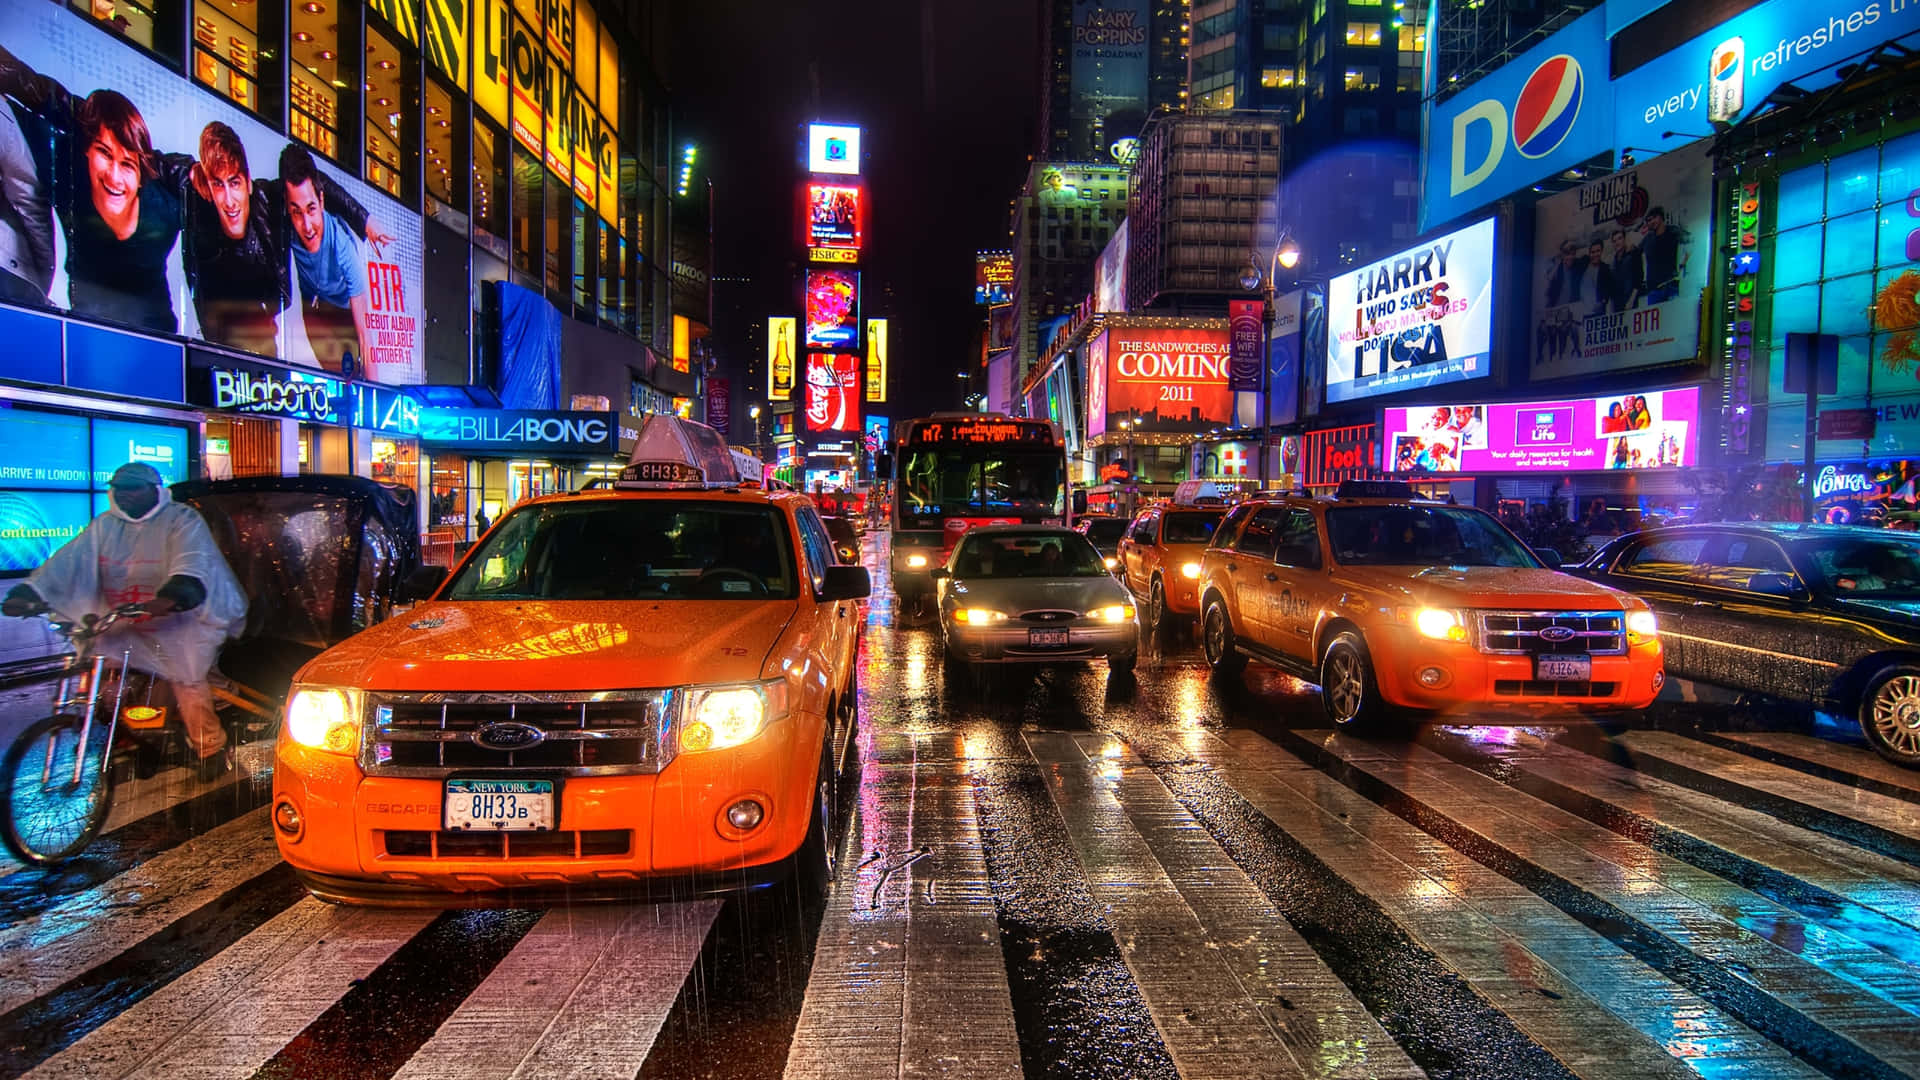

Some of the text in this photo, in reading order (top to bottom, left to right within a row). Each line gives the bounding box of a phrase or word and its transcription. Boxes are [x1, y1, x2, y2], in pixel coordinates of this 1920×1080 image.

[1088, 11, 1135, 27] MARY
[1076, 26, 1145, 45] POPPINS
[1751, 2, 1881, 77] refreshes
[485, 0, 611, 180] LION KING
[1644, 84, 1702, 124] every
[1582, 173, 1636, 208] BIG TIME
[1599, 193, 1632, 221] RUSH
[810, 249, 840, 260] HSBC
[1356, 240, 1454, 305] HARRY
[368, 261, 405, 312] BTR
[1366, 286, 1434, 320] WHO SAYS
[364, 313, 416, 332] DEBUT ALBUM
[1586, 307, 1660, 335] DEBUT BTR
[378, 331, 414, 348] AVAILABLE
[1235, 331, 1257, 342] FREE
[1585, 326, 1629, 347] ALBUM
[370, 347, 404, 363] OCTOBER
[1119, 341, 1142, 352] THE
[1144, 342, 1217, 353] SANDWICHES
[1354, 325, 1448, 379] LISA
[1584, 343, 1622, 358] OCTOBER
[1624, 341, 1633, 353] 11
[1159, 386, 1193, 402] 2011
[460, 416, 609, 443] BILLABONG
[1531, 430, 1556, 441] Life
[1325, 444, 1363, 469] Foot
[1509, 450, 1527, 459] daily
[1561, 448, 1571, 457] for
[1573, 448, 1594, 456] health
[36, 469, 46, 480] IN
[48, 469, 86, 481] LONDON
[642, 464, 680, 480] 8H33
[490, 730, 523, 742] Ford
[473, 784, 527, 793] NEW YORK
[367, 803, 441, 815] ESCAPE
